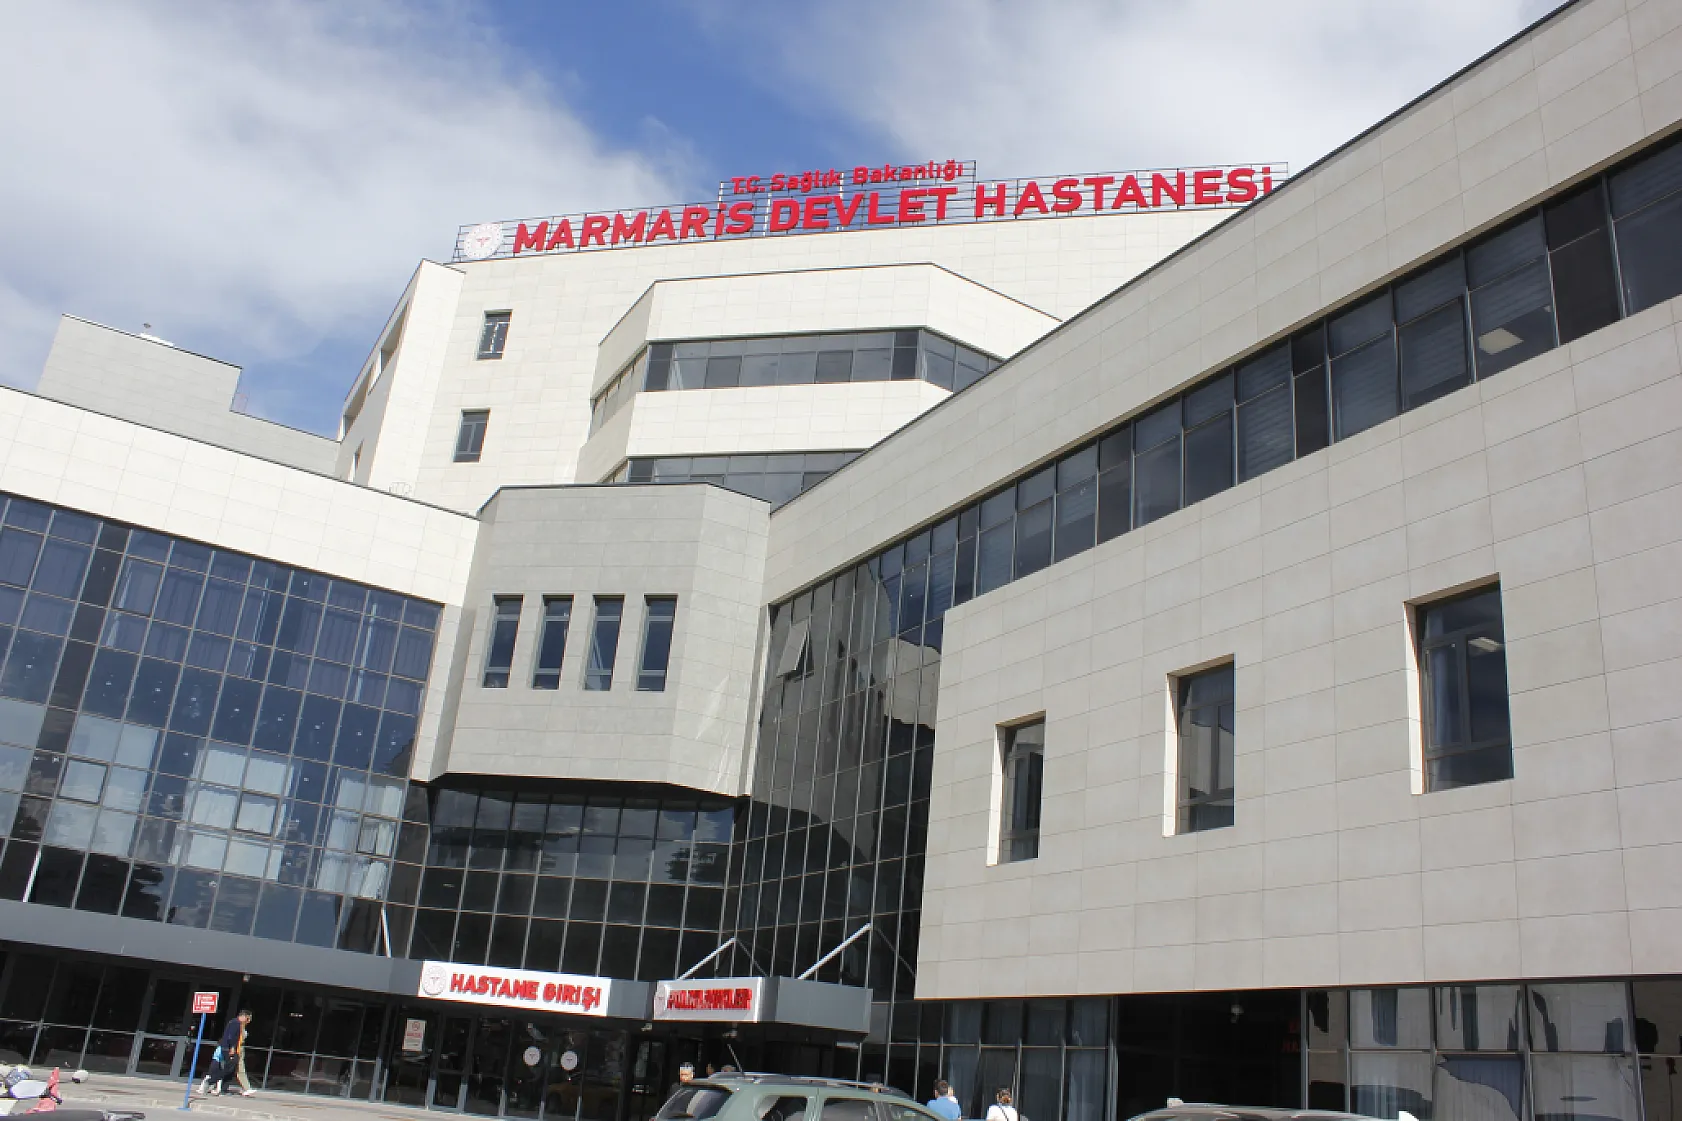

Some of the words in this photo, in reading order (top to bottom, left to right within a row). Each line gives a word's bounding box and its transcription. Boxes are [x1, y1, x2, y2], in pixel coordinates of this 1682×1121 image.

[731, 175, 766, 194] T.C.
[769, 169, 842, 192] Sağlık
[852, 159, 964, 184] Bakanlığı
[769, 186, 958, 232] DEVLET
[450, 973, 540, 1001] HASTANE
